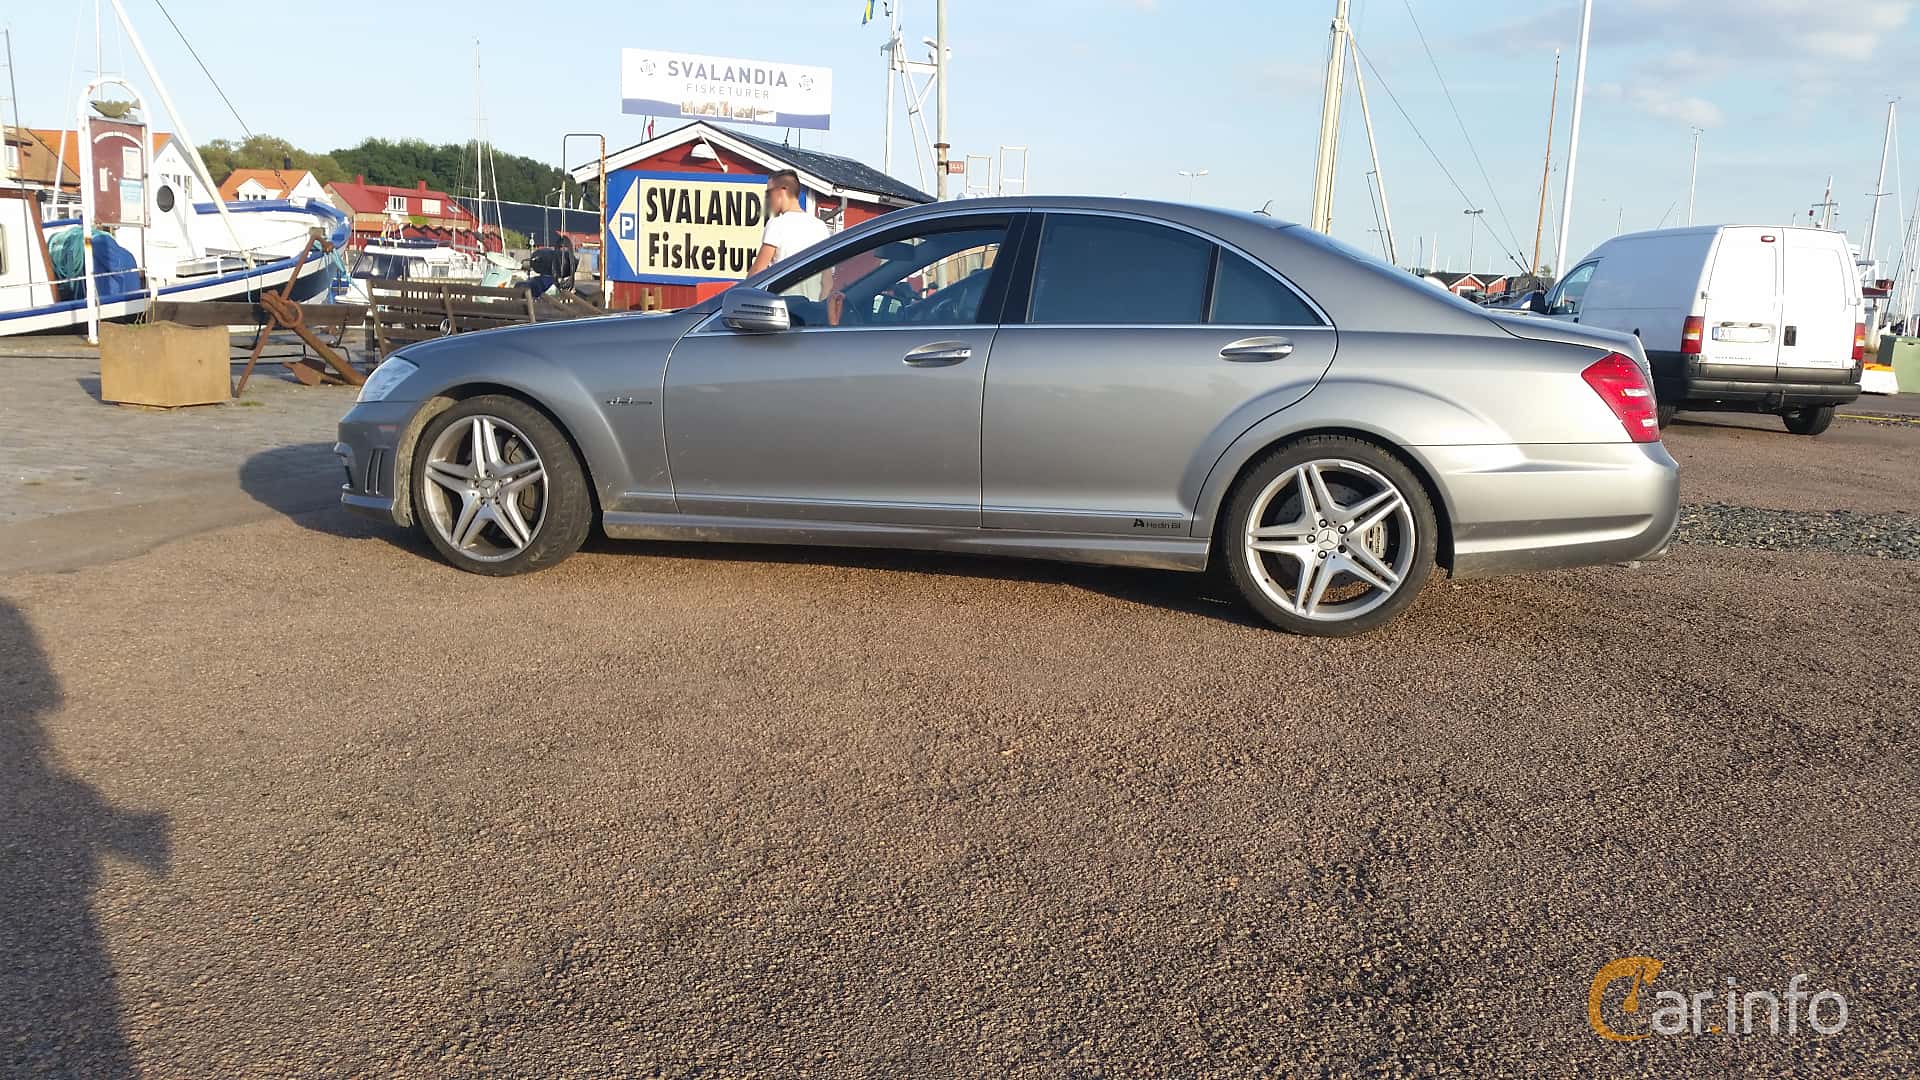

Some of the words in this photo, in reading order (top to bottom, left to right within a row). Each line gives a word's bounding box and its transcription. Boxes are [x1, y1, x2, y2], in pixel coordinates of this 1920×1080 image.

[667, 60, 788, 88] SVALANDIA
[686, 83, 769, 99] FISKETURER
[646, 187, 769, 227] SVALAND
[621, 216, 634, 237] P
[648, 232, 757, 273] Fisketur
